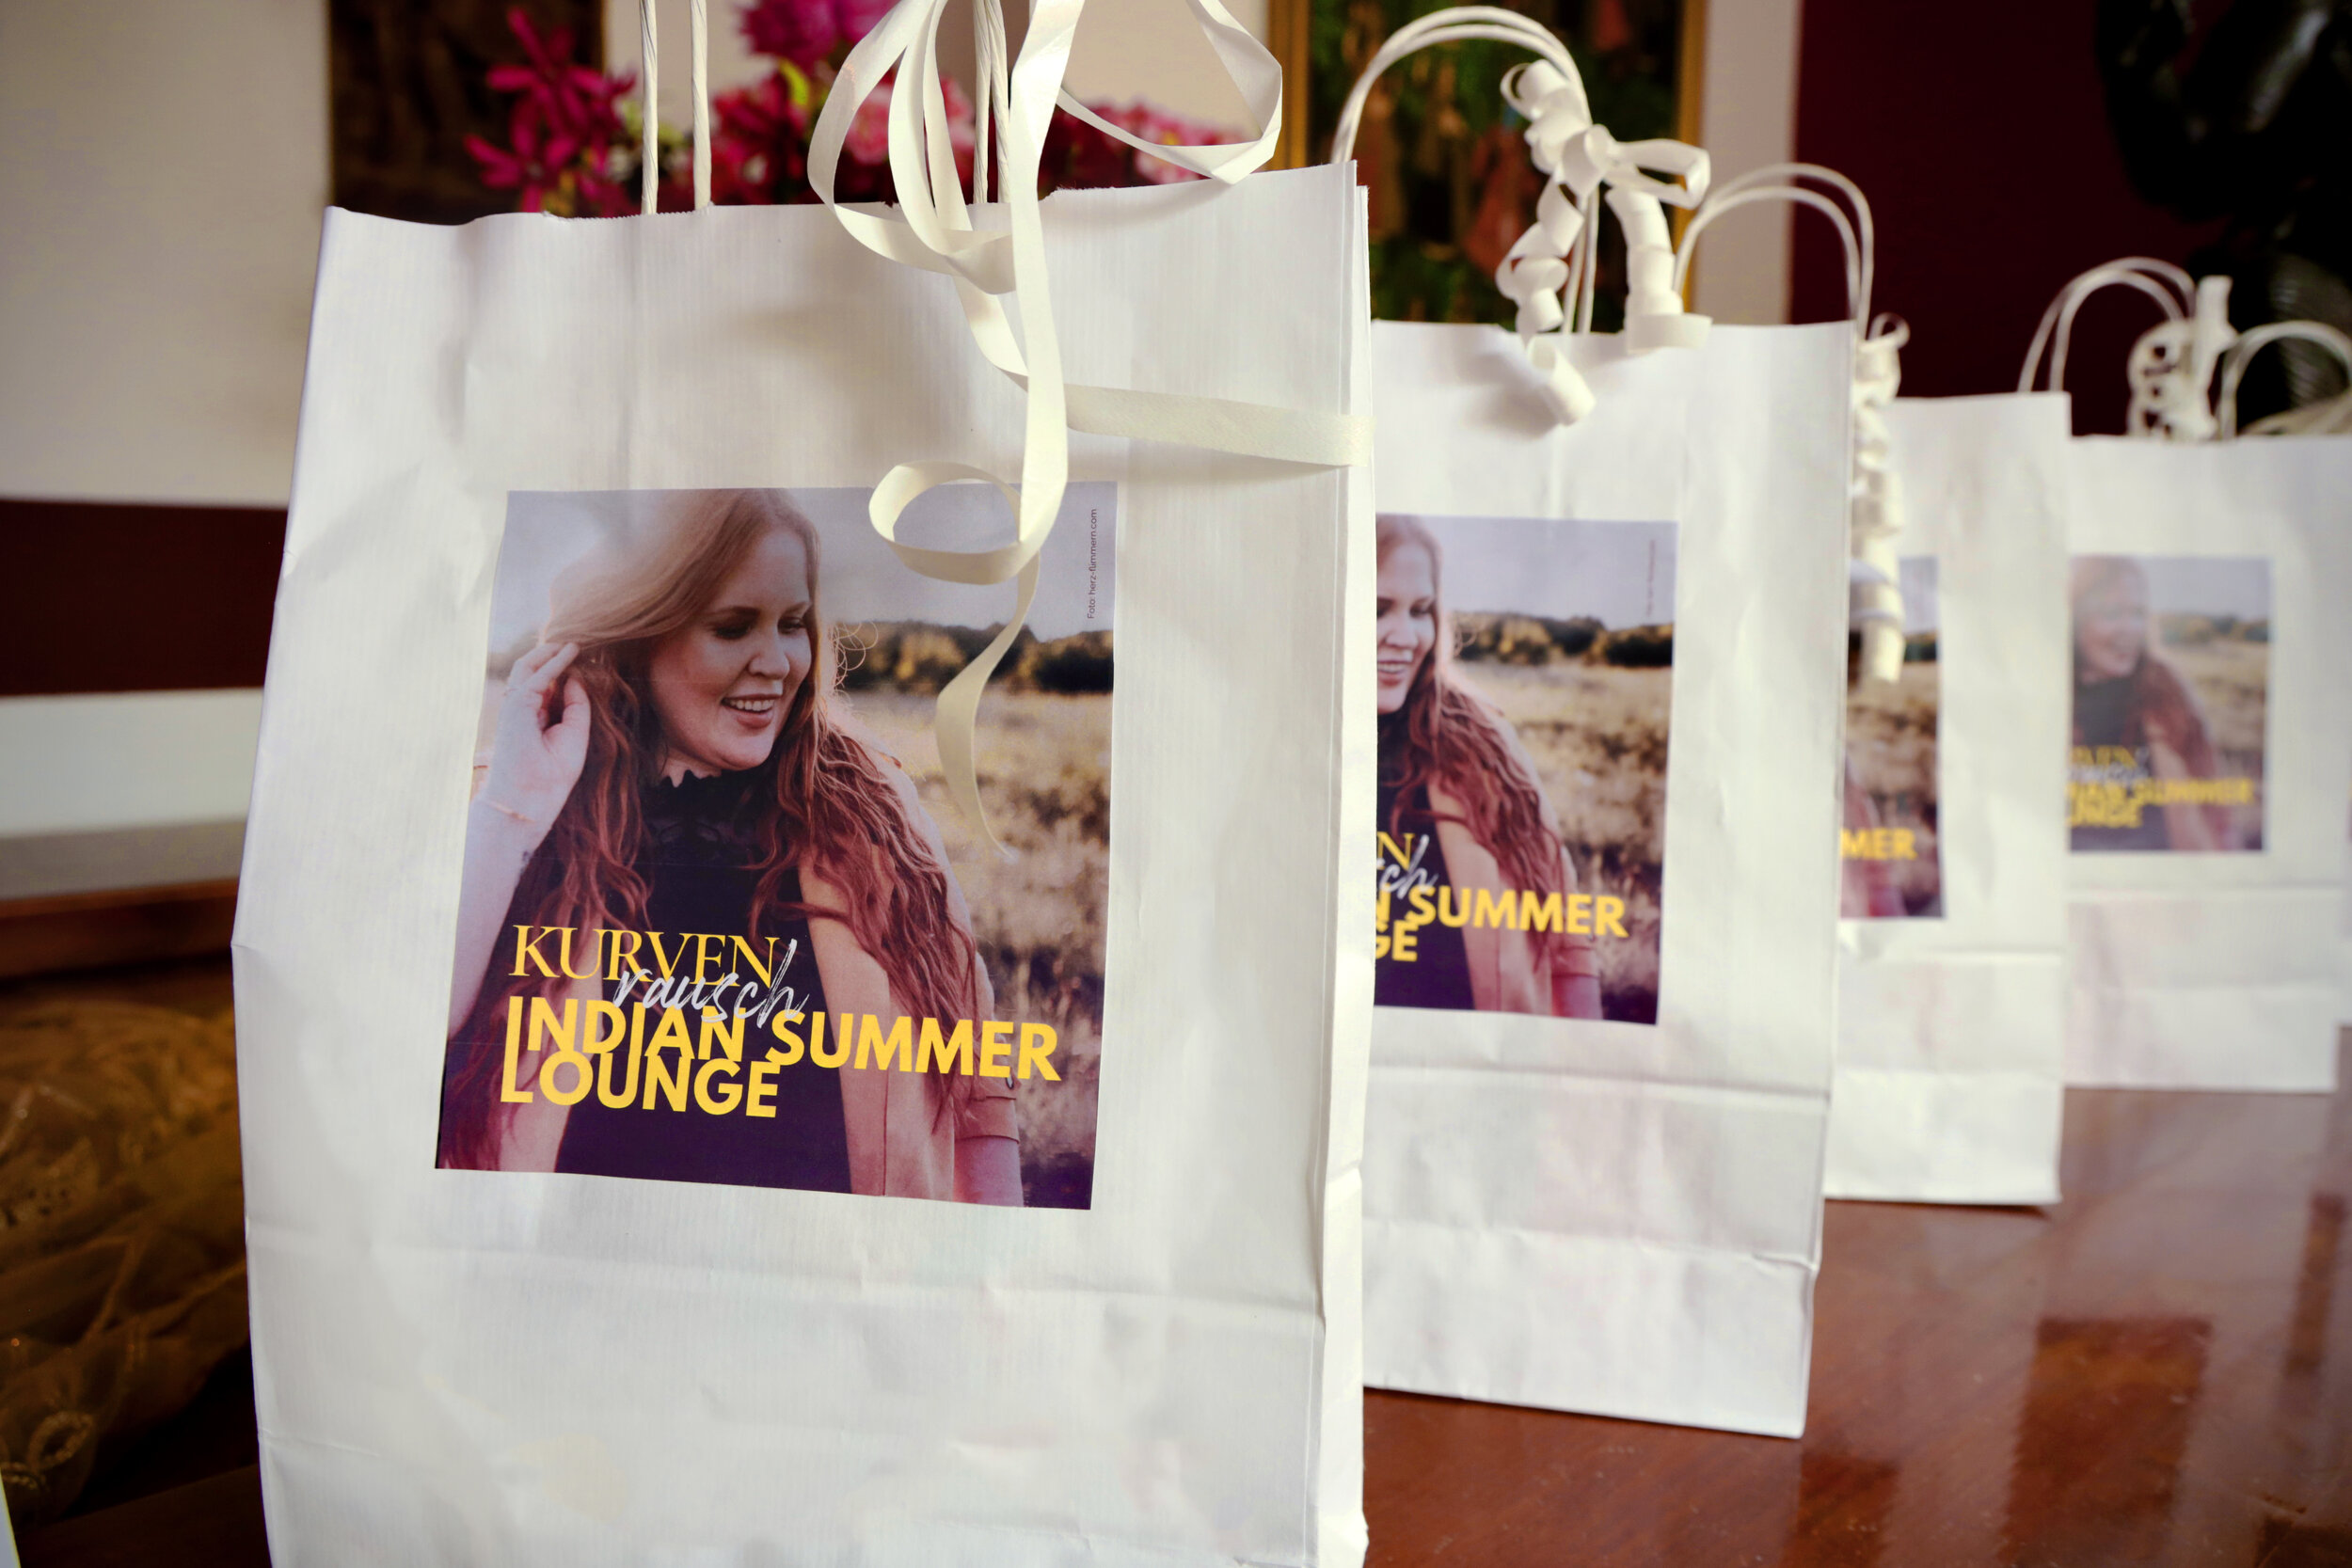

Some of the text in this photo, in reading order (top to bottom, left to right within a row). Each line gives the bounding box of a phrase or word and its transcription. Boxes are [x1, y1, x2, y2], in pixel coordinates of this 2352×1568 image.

[1087, 596, 1097, 619] Foto:
[1405, 885, 1629, 938] SUMMER
[508, 925, 780, 989] KURVEN
[613, 938, 810, 1029] rausch
[508, 995, 1061, 1081] INDIAN SUMMER
[501, 1049, 781, 1118] LOUNGE
